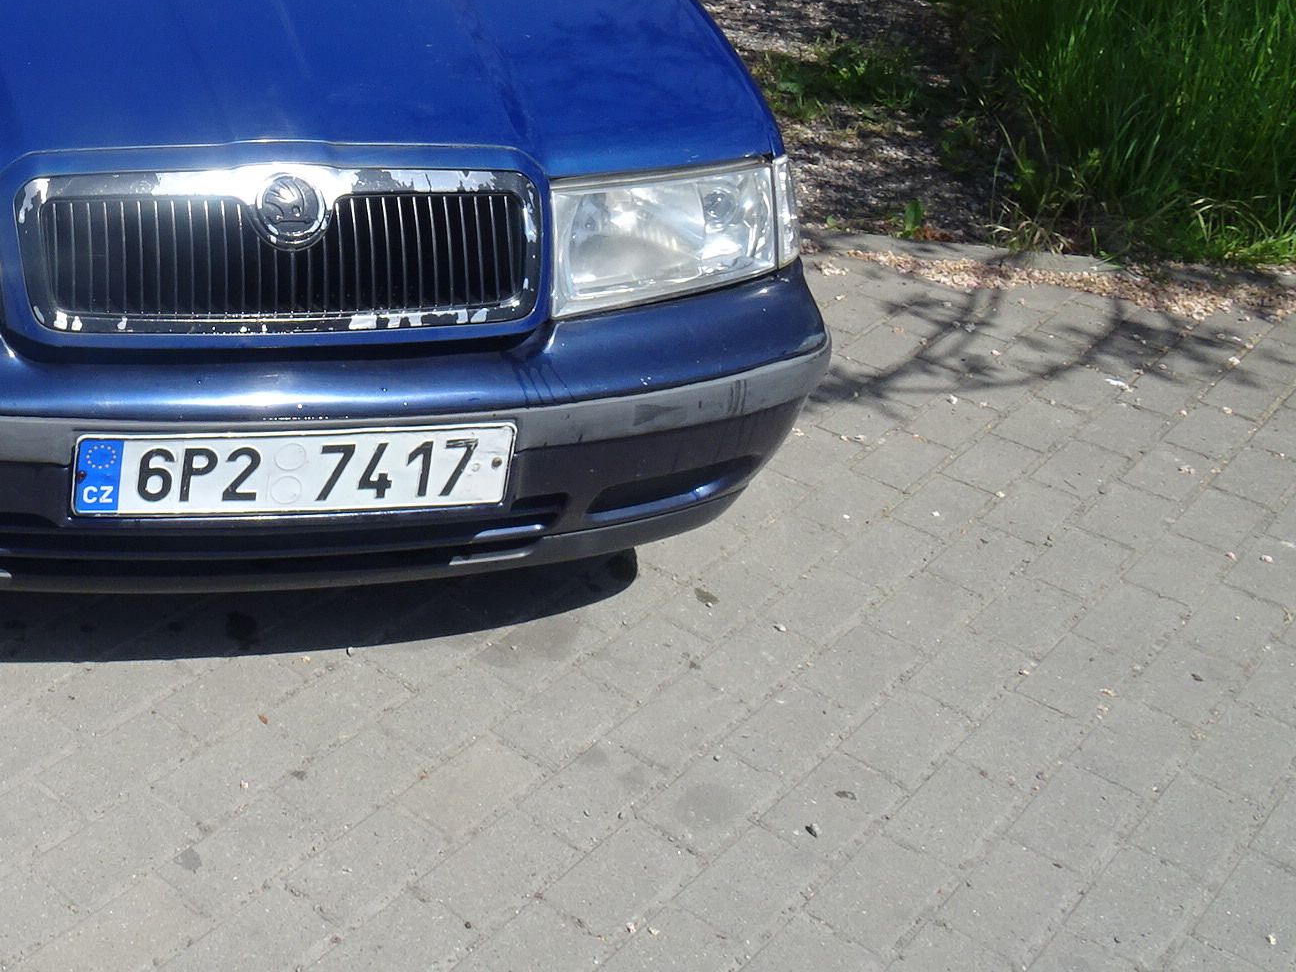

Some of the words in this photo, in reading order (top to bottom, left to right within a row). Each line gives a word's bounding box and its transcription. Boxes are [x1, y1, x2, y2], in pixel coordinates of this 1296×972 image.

[137, 447, 261, 502] 6P2
[315, 439, 479, 502] 7417
[83, 485, 114, 504] CZ
